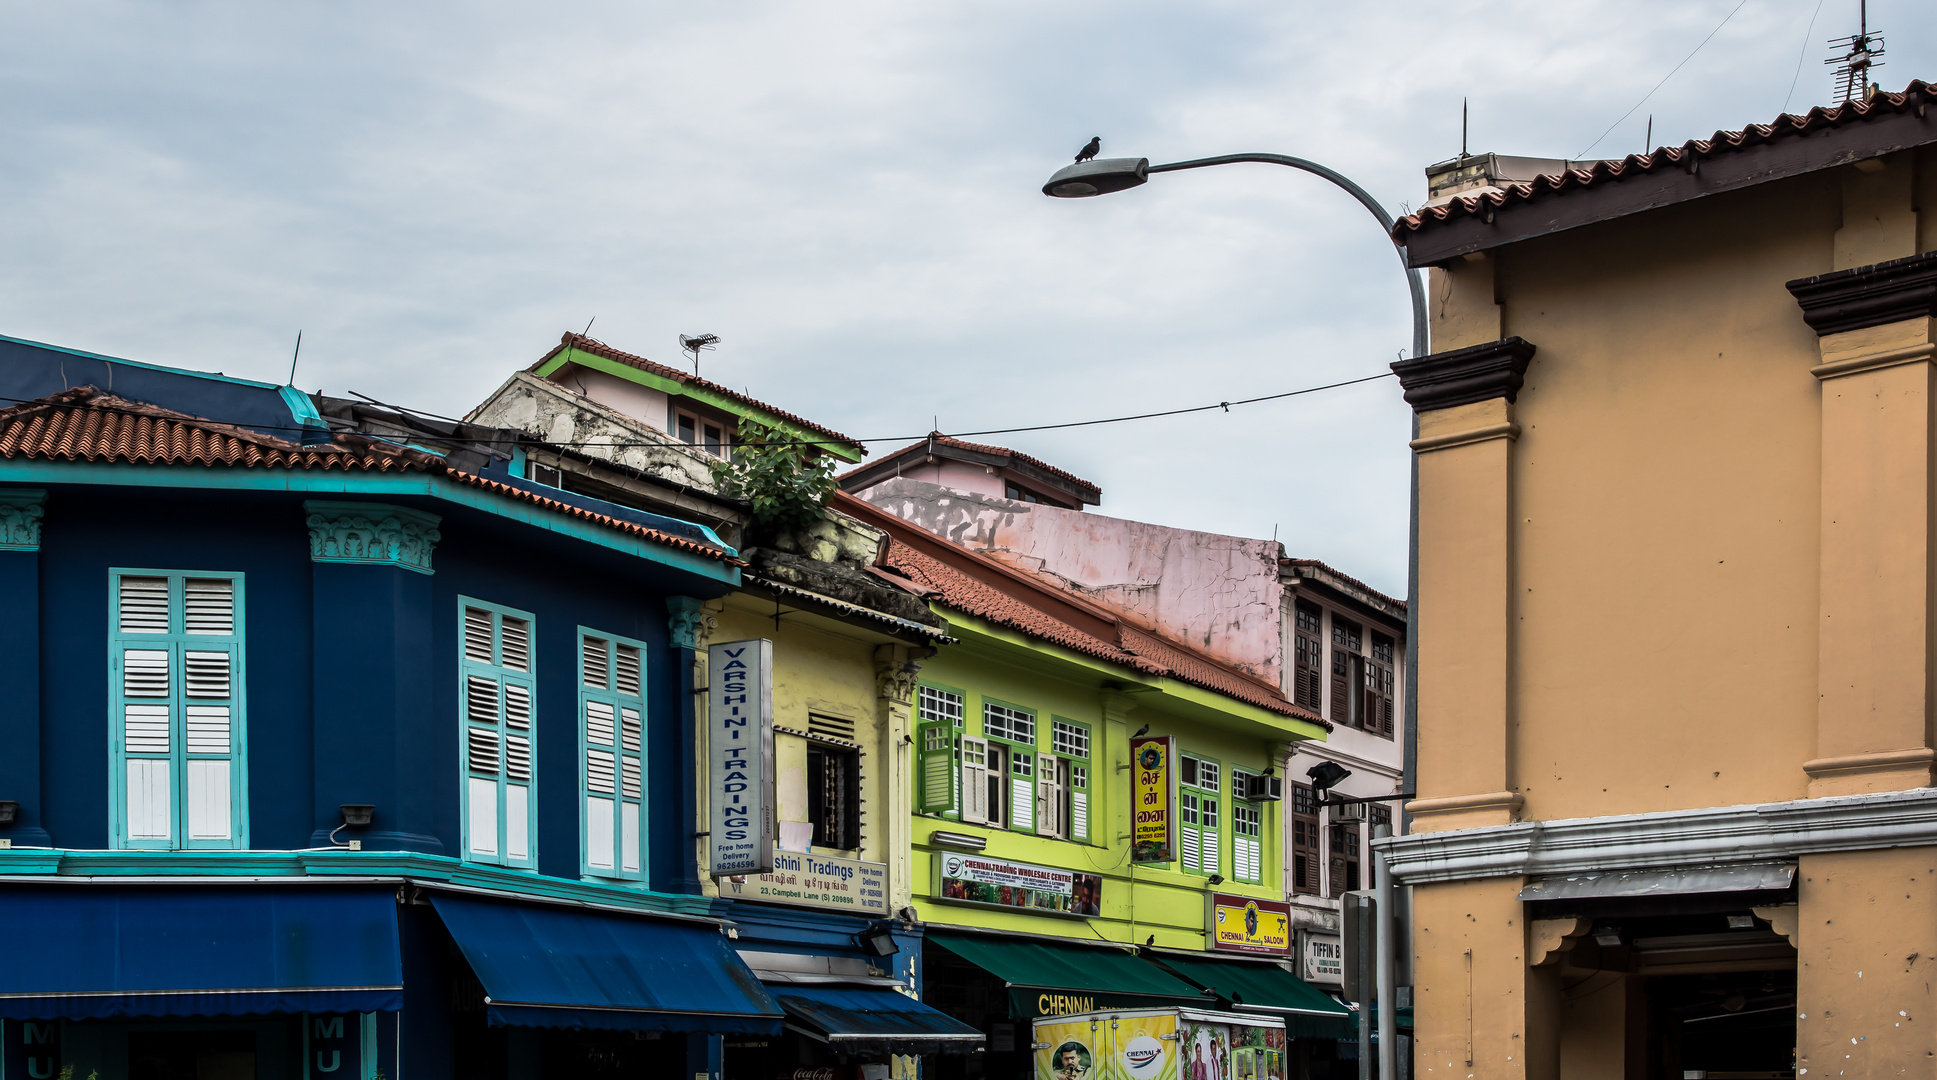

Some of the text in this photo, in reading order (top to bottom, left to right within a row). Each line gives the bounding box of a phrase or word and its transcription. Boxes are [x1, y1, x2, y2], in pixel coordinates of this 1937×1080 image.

[723, 648, 749, 841] VARSHINI TRADINGS
[718, 844, 734, 852] Free
[723, 852, 750, 861] Delivery
[717, 861, 755, 870] 96264596
[773, 855, 854, 882] shini Tradings
[859, 866, 883, 877] Free home
[964, 859, 991, 871] CHENNAI
[992, 863, 1018, 875] TRADING
[1018, 868, 1051, 880] WHOLESALE
[1051, 872, 1072, 883] CENTRE
[862, 877, 881, 888] Delivery
[761, 887, 772, 896] 23,
[772, 888, 801, 898] Campbell
[804, 891, 819, 900] Lane
[821, 893, 830, 902] (S)
[1221, 931, 1244, 942] CHENNAI
[1263, 935, 1284, 945] SALOON
[1312, 942, 1334, 958] TIFFIN
[1038, 993, 1094, 1016] CHENNAI
[1126, 1049, 1155, 1058] CHENNAI
